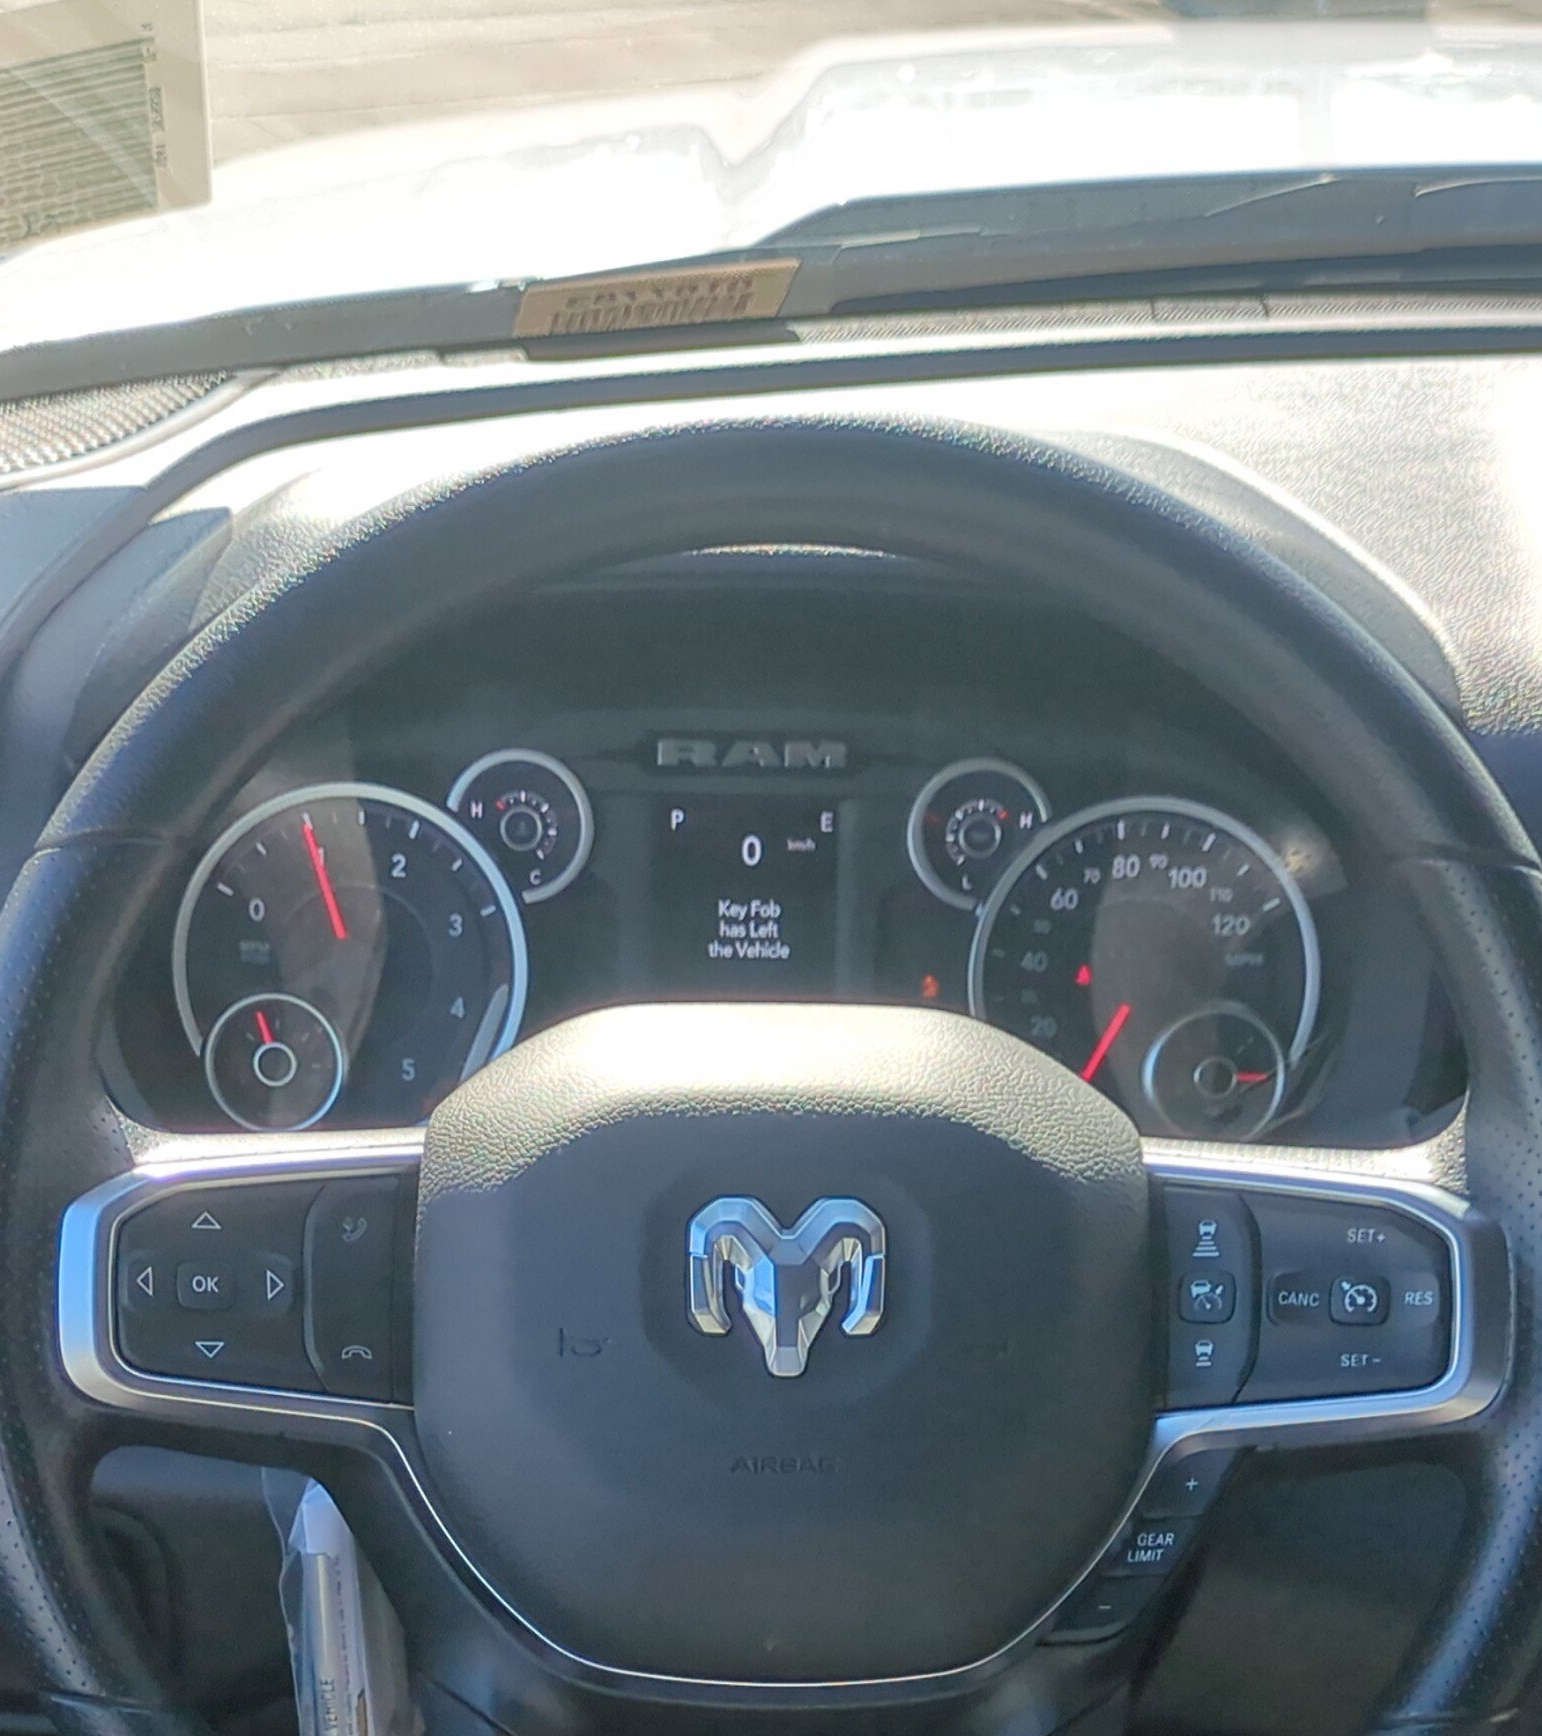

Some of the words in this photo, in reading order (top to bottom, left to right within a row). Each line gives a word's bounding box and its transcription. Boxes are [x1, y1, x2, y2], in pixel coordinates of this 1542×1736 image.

[656, 738, 846, 767] RAM
[470, 801, 483, 819] H
[671, 808, 685, 830] P
[1019, 812, 1033, 829] H
[820, 811, 833, 832] E
[741, 834, 762, 866] 0
[390, 854, 408, 878] 2
[1112, 855, 1140, 879] 80
[1149, 854, 1168, 870] 90
[529, 868, 542, 886] C
[963, 876, 972, 891] L
[1083, 868, 1101, 884] 70
[1168, 866, 1207, 889] 100
[248, 898, 265, 921] 0
[718, 899, 748, 920] Key
[750, 899, 781, 919] Fob
[1050, 889, 1079, 910] 60
[449, 914, 464, 937] 3
[719, 920, 746, 938] has
[749, 920, 779, 938] Left
[1211, 912, 1250, 937] 120
[708, 941, 733, 959] the
[736, 941, 791, 960] Vehicle
[1021, 951, 1048, 973] 40
[450, 996, 466, 1019] 4
[1031, 1015, 1056, 1038] 20
[401, 1059, 417, 1081] 5
[192, 1275, 219, 1293] OK
[1278, 1291, 1320, 1307] CANC
[1404, 1291, 1433, 1306] RES
[730, 1455, 842, 1475] AIRBAG
[1137, 1532, 1175, 1547] GEAR
[1127, 1549, 1164, 1563] LIMIT
